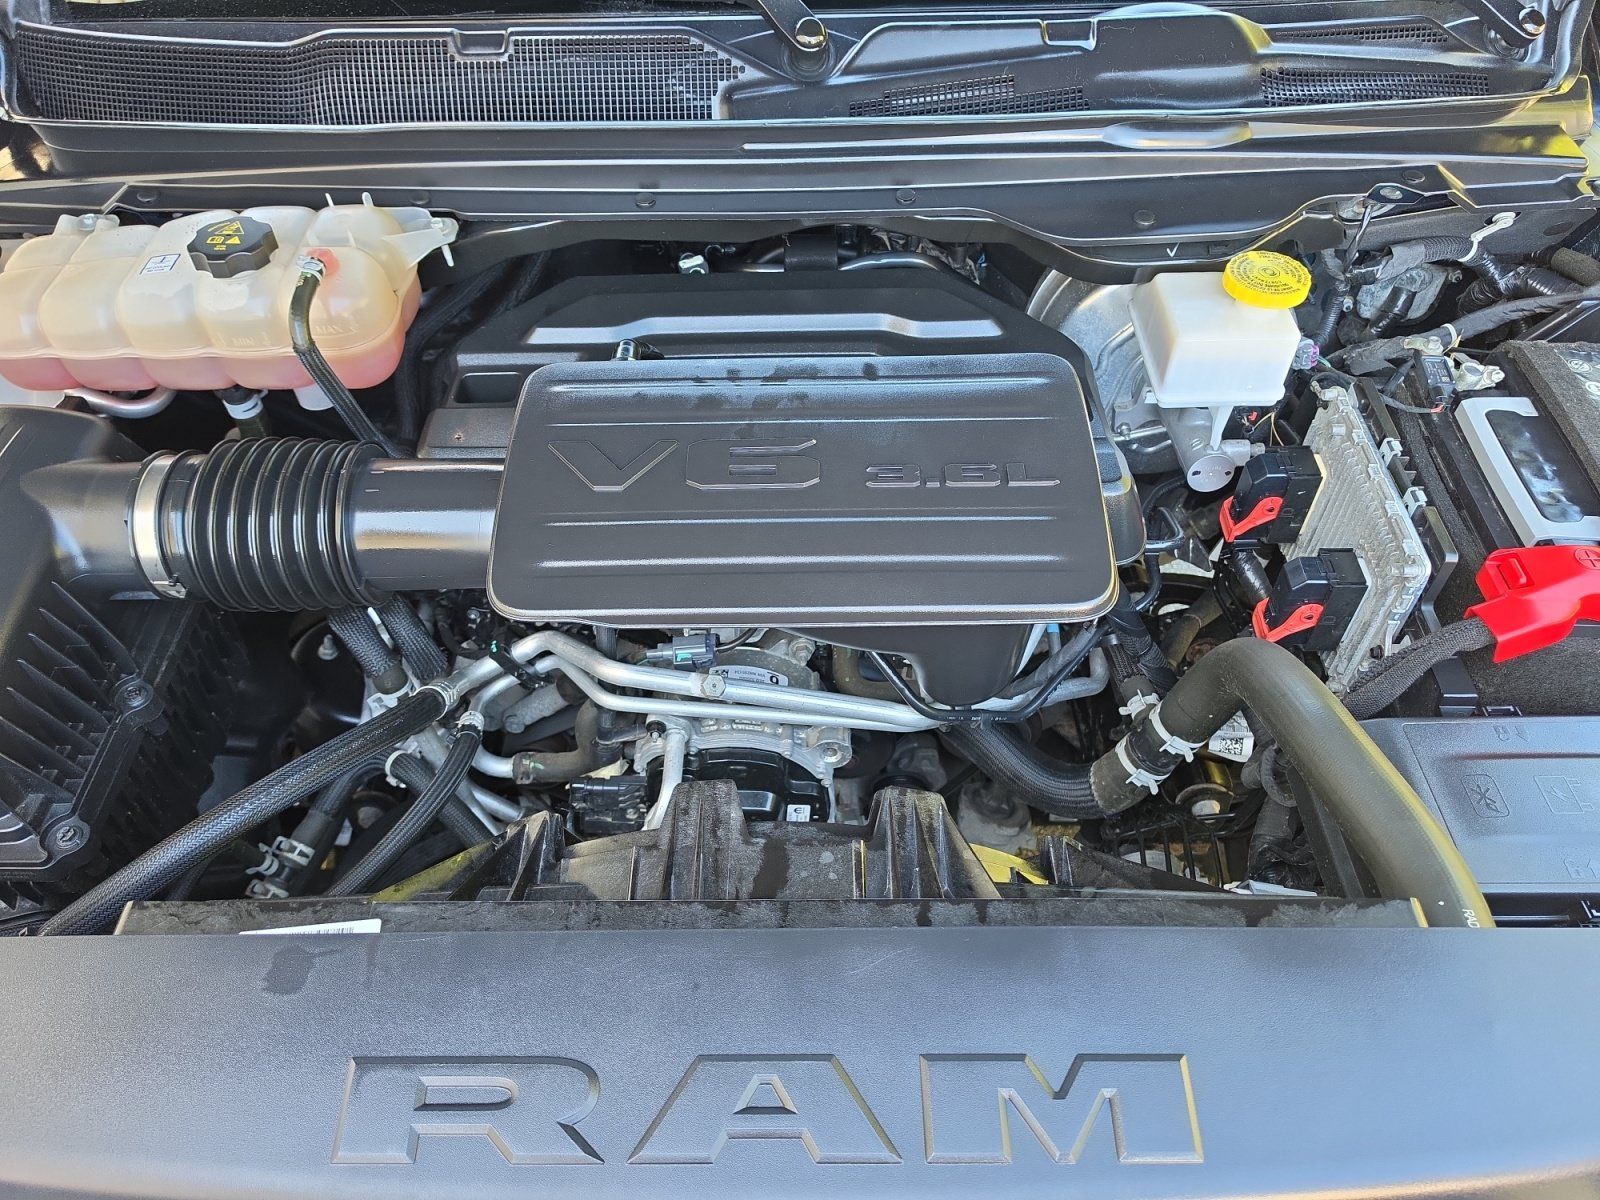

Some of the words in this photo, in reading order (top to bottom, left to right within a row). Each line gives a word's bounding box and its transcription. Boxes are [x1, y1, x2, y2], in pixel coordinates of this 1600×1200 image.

[547, 438, 821, 492] V6
[865, 461, 1061, 489] 3.6L
[330, 1053, 1205, 1165] RAM
